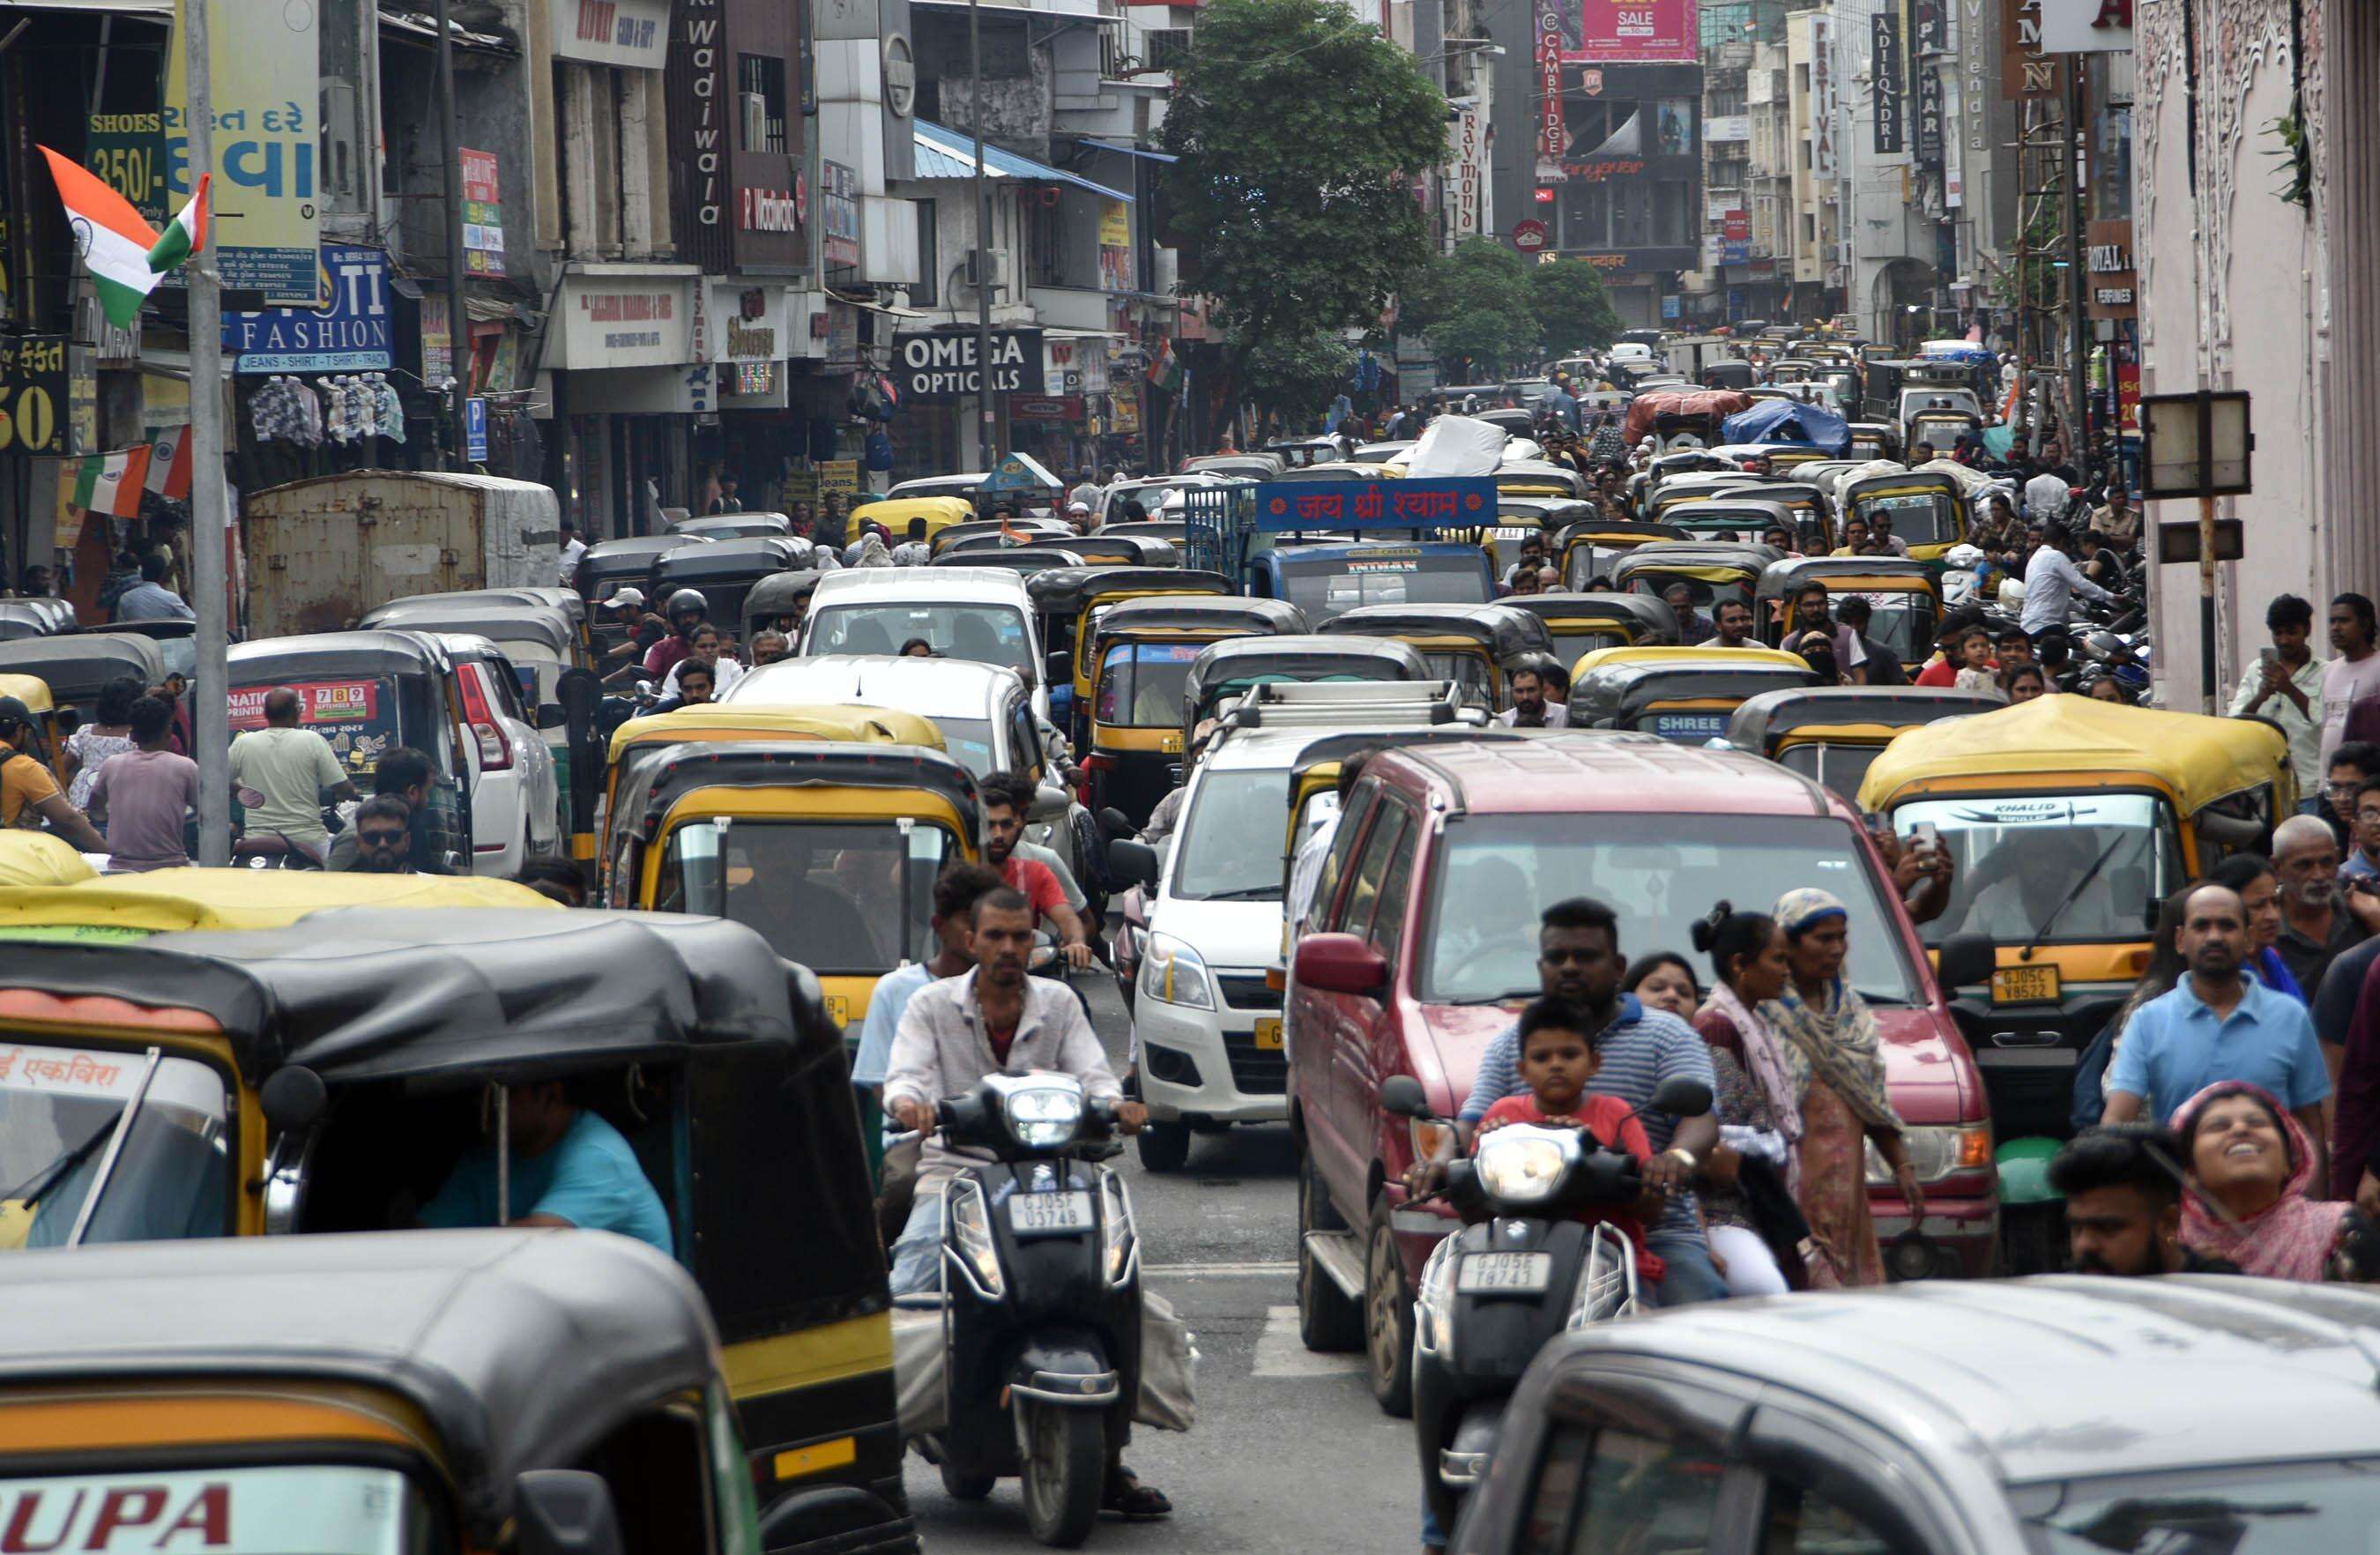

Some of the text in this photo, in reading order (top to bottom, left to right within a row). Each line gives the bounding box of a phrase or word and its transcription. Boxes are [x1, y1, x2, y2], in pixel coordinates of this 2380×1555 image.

[1618, 11, 1654, 26] SALE
[1876, 18, 1898, 149] ADILQADRI
[1967, 2, 1982, 149] Virendra
[1544, 34, 1559, 153] CAMBRIDGE
[1816, 22, 1830, 171] FESTIVAL
[91, 113, 160, 133] SHOES
[688, 20, 719, 225] Wadiwala
[1460, 115, 1476, 227] Raymond
[1561, 160, 1645, 182] anyavar
[242, 320, 385, 349] FASHION
[244, 356, 279, 368] JEANS
[288, 355, 316, 368] SHIRT
[912, 369, 1020, 394] OPTICLS
[472, 401, 480, 431] P
[1297, 485, 1459, 521] जय श्री श्याम
[1659, 717, 1722, 730] SHREE
[1994, 803, 2057, 813] KHALID
[2004, 969, 2046, 984] GJ05C
[23, 1053, 121, 1086] एकविरा
